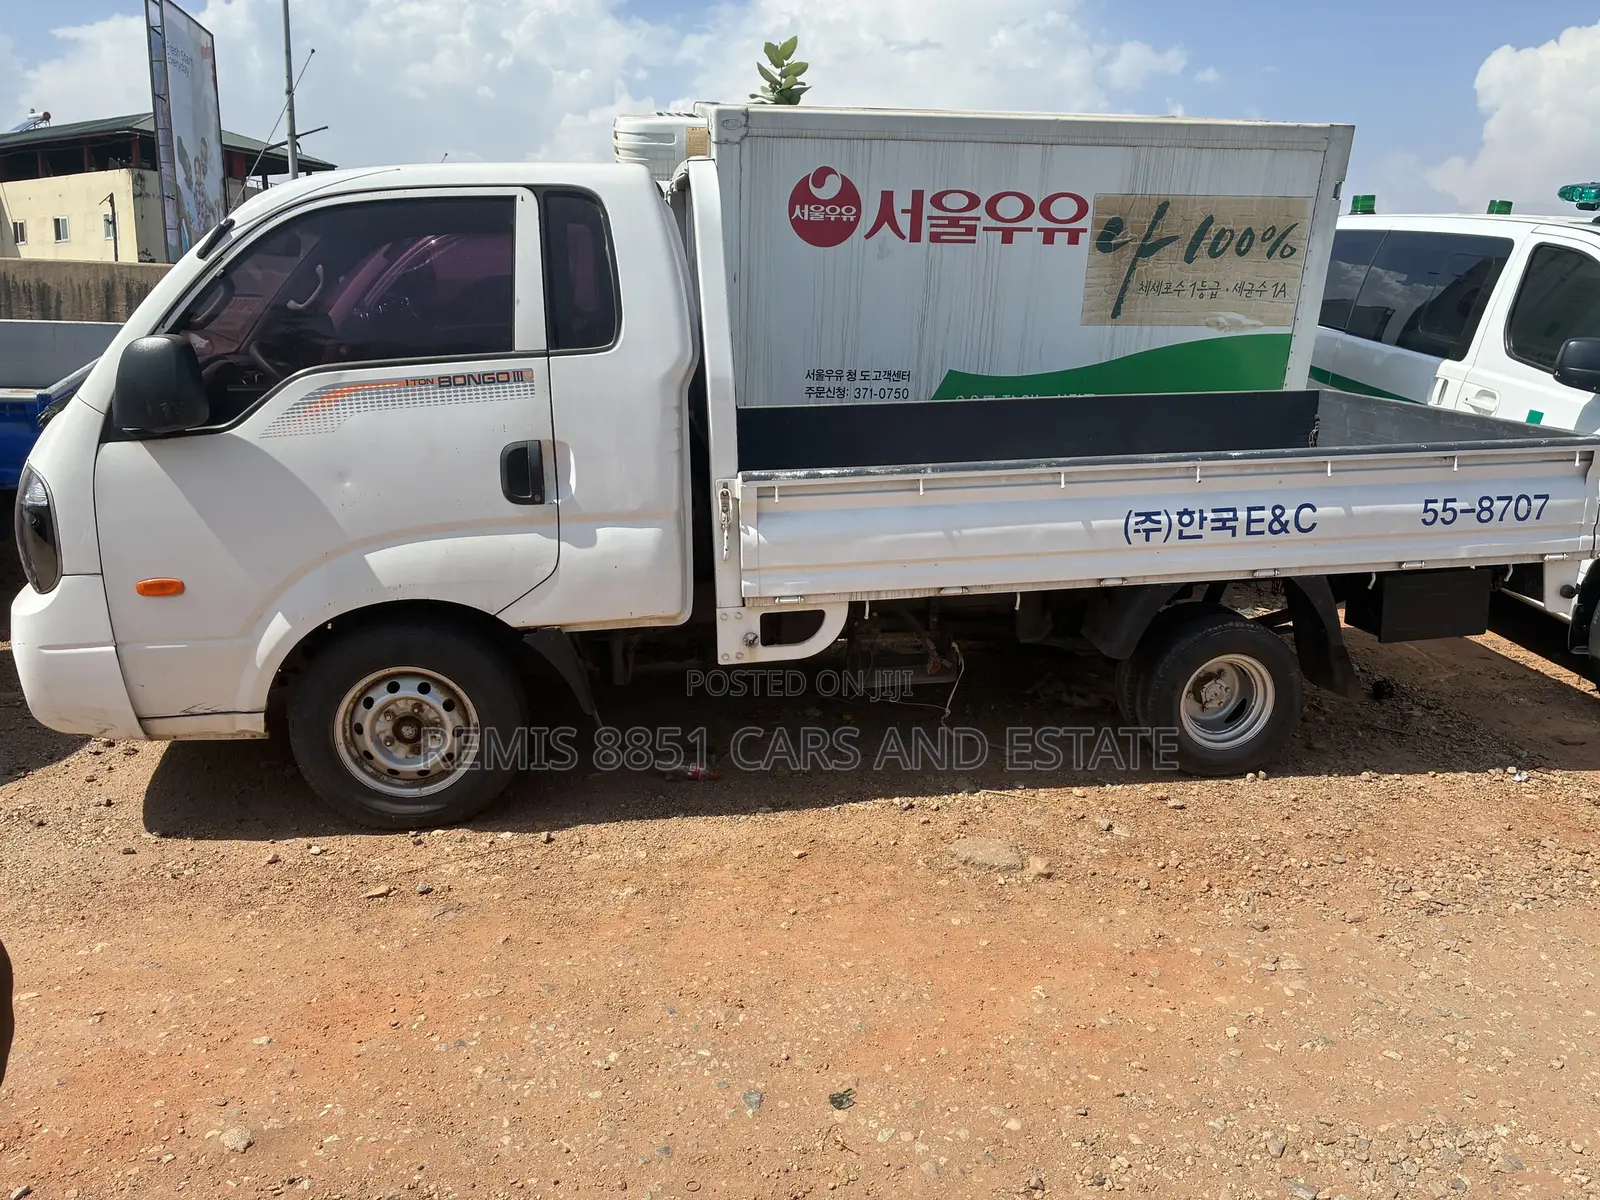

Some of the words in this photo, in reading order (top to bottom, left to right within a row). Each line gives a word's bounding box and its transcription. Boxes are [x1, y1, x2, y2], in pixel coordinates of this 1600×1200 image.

[791, 204, 857, 221] 서울우유
[863, 189, 1089, 245] 서울우유
[1139, 280, 1186, 298] 체세포수
[1232, 280, 1268, 299] 세균수
[1272, 282, 1287, 298] 1A
[438, 371, 510, 388] BONGO
[805, 369, 844, 381] 서울우유
[804, 386, 850, 399] 주문신청:
[854, 387, 909, 399] 371-0750
[1421, 494, 1550, 526] 55-8707
